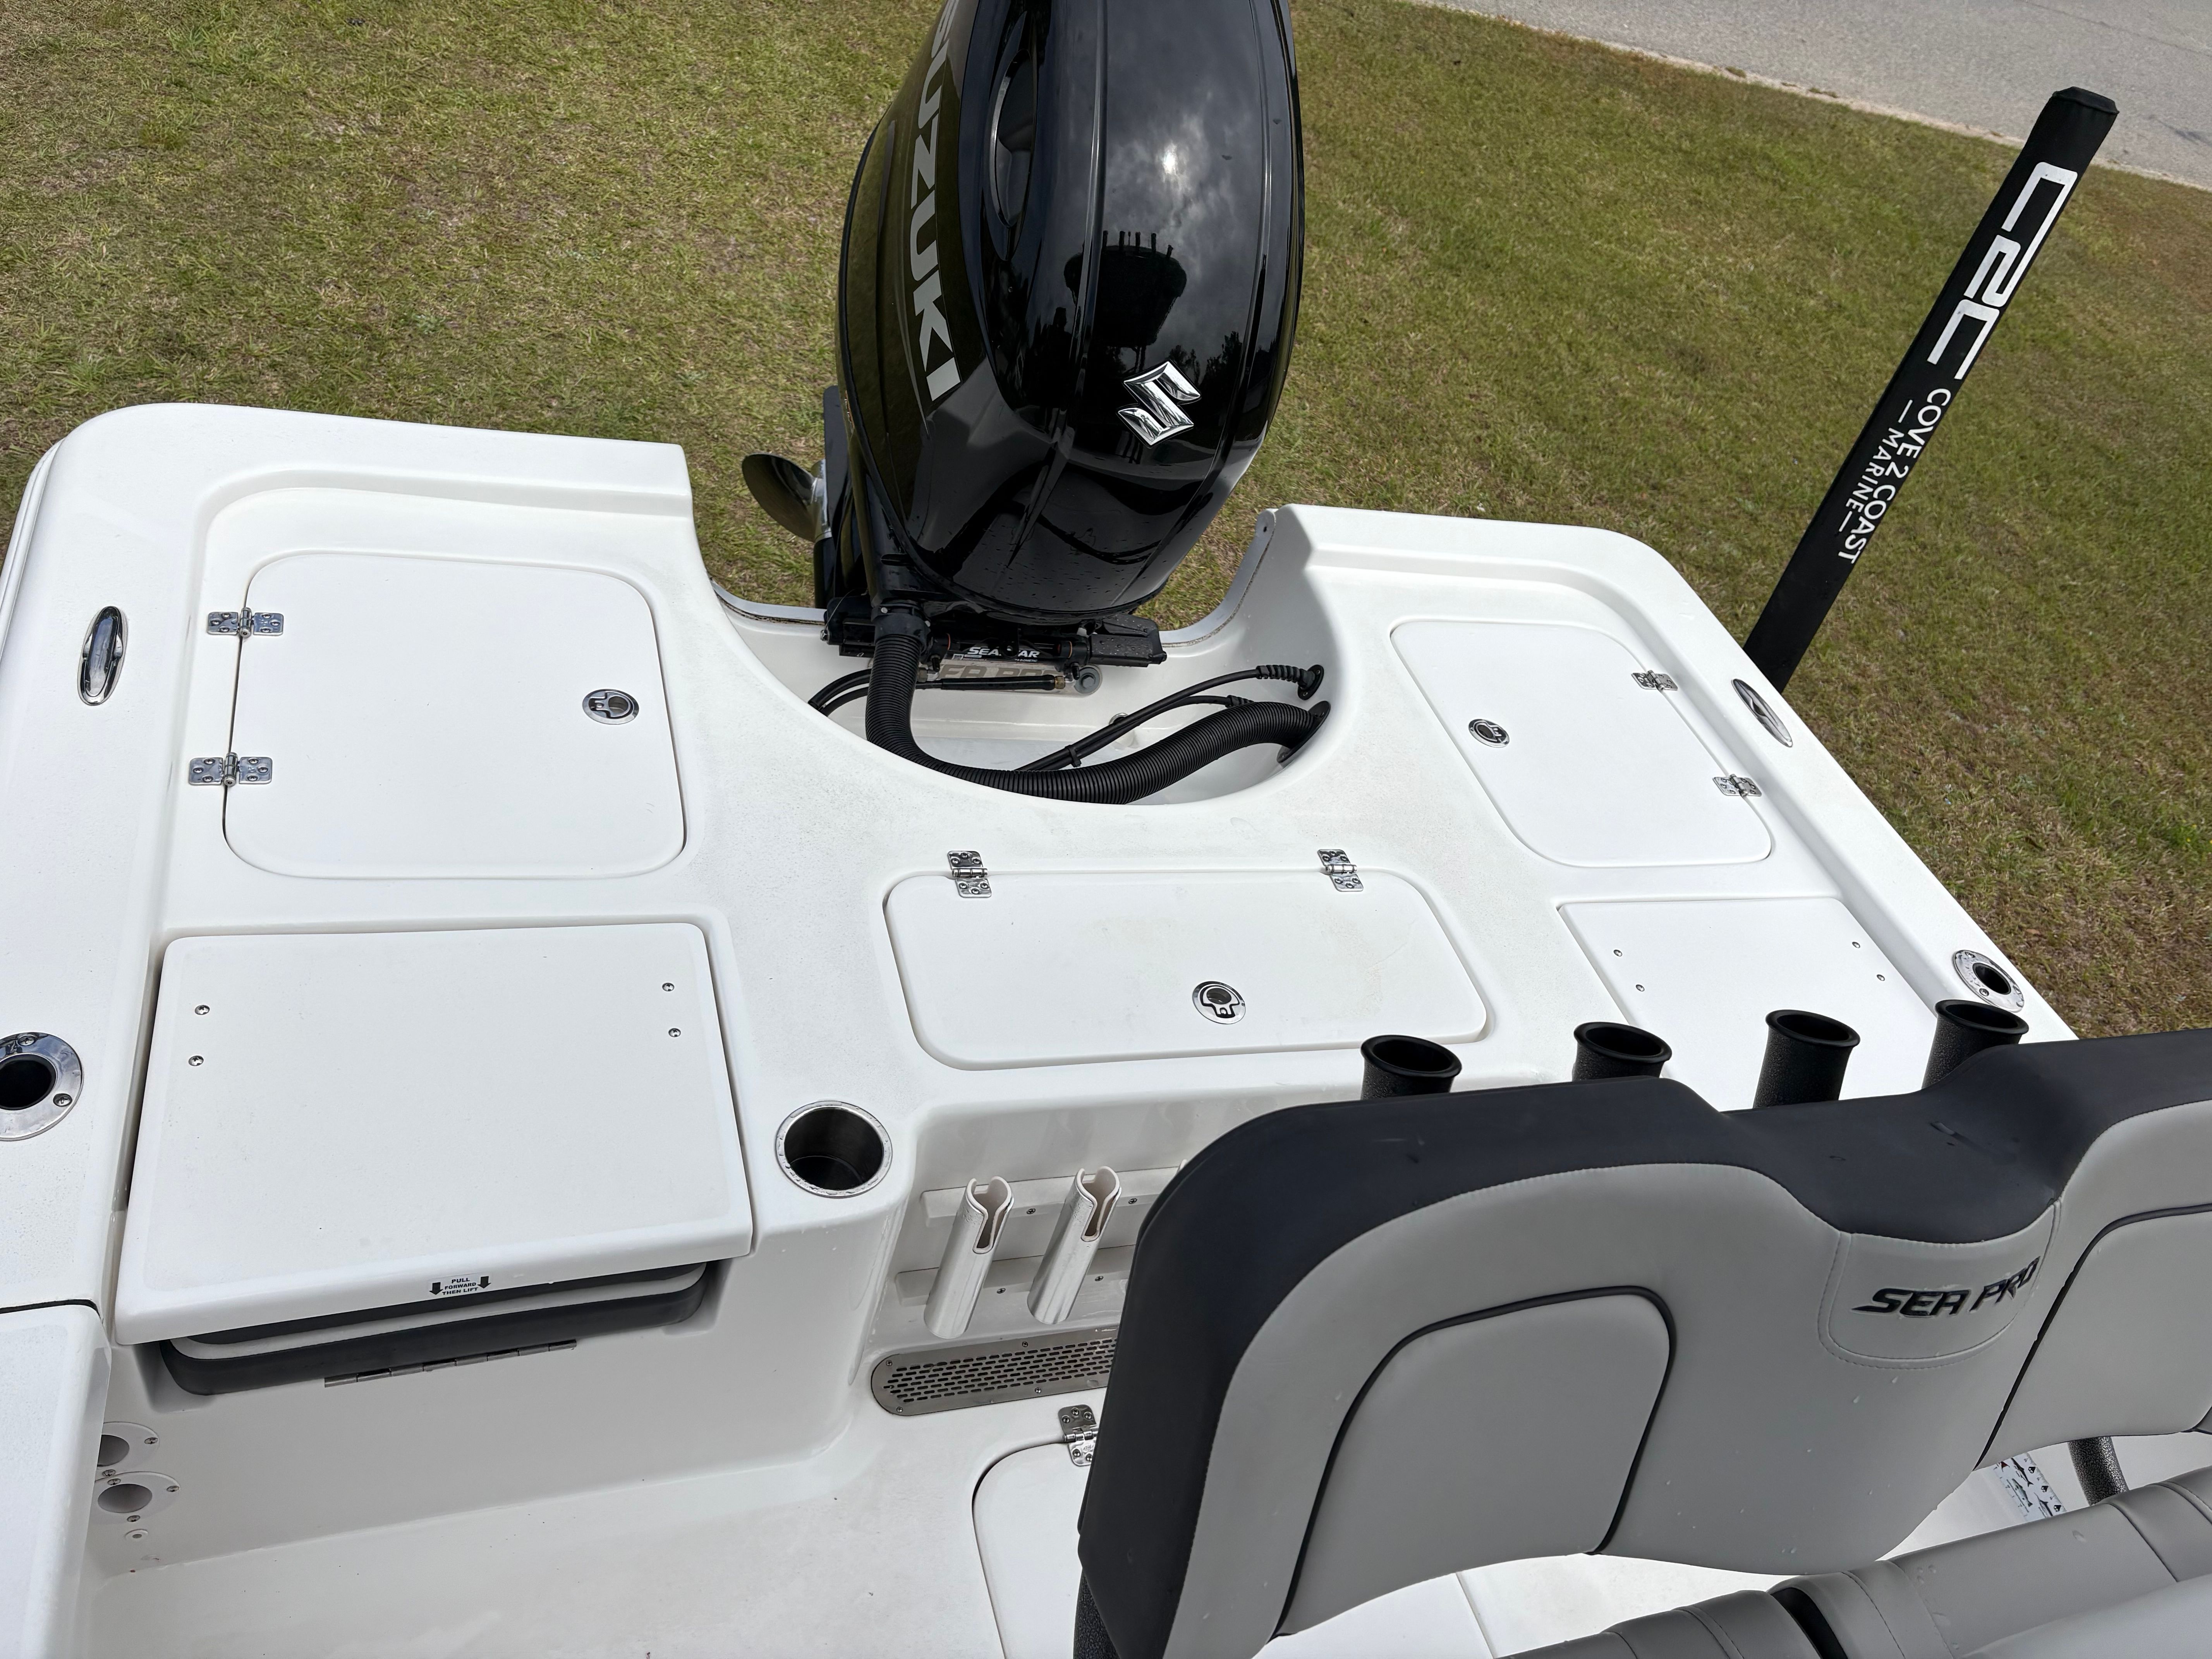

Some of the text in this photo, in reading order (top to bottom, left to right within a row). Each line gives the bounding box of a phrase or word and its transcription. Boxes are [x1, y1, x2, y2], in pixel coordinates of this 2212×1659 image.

[1838, 388, 1951, 564] COVE 2 COAST
[1851, 1255, 2041, 1317] SEA PRO
